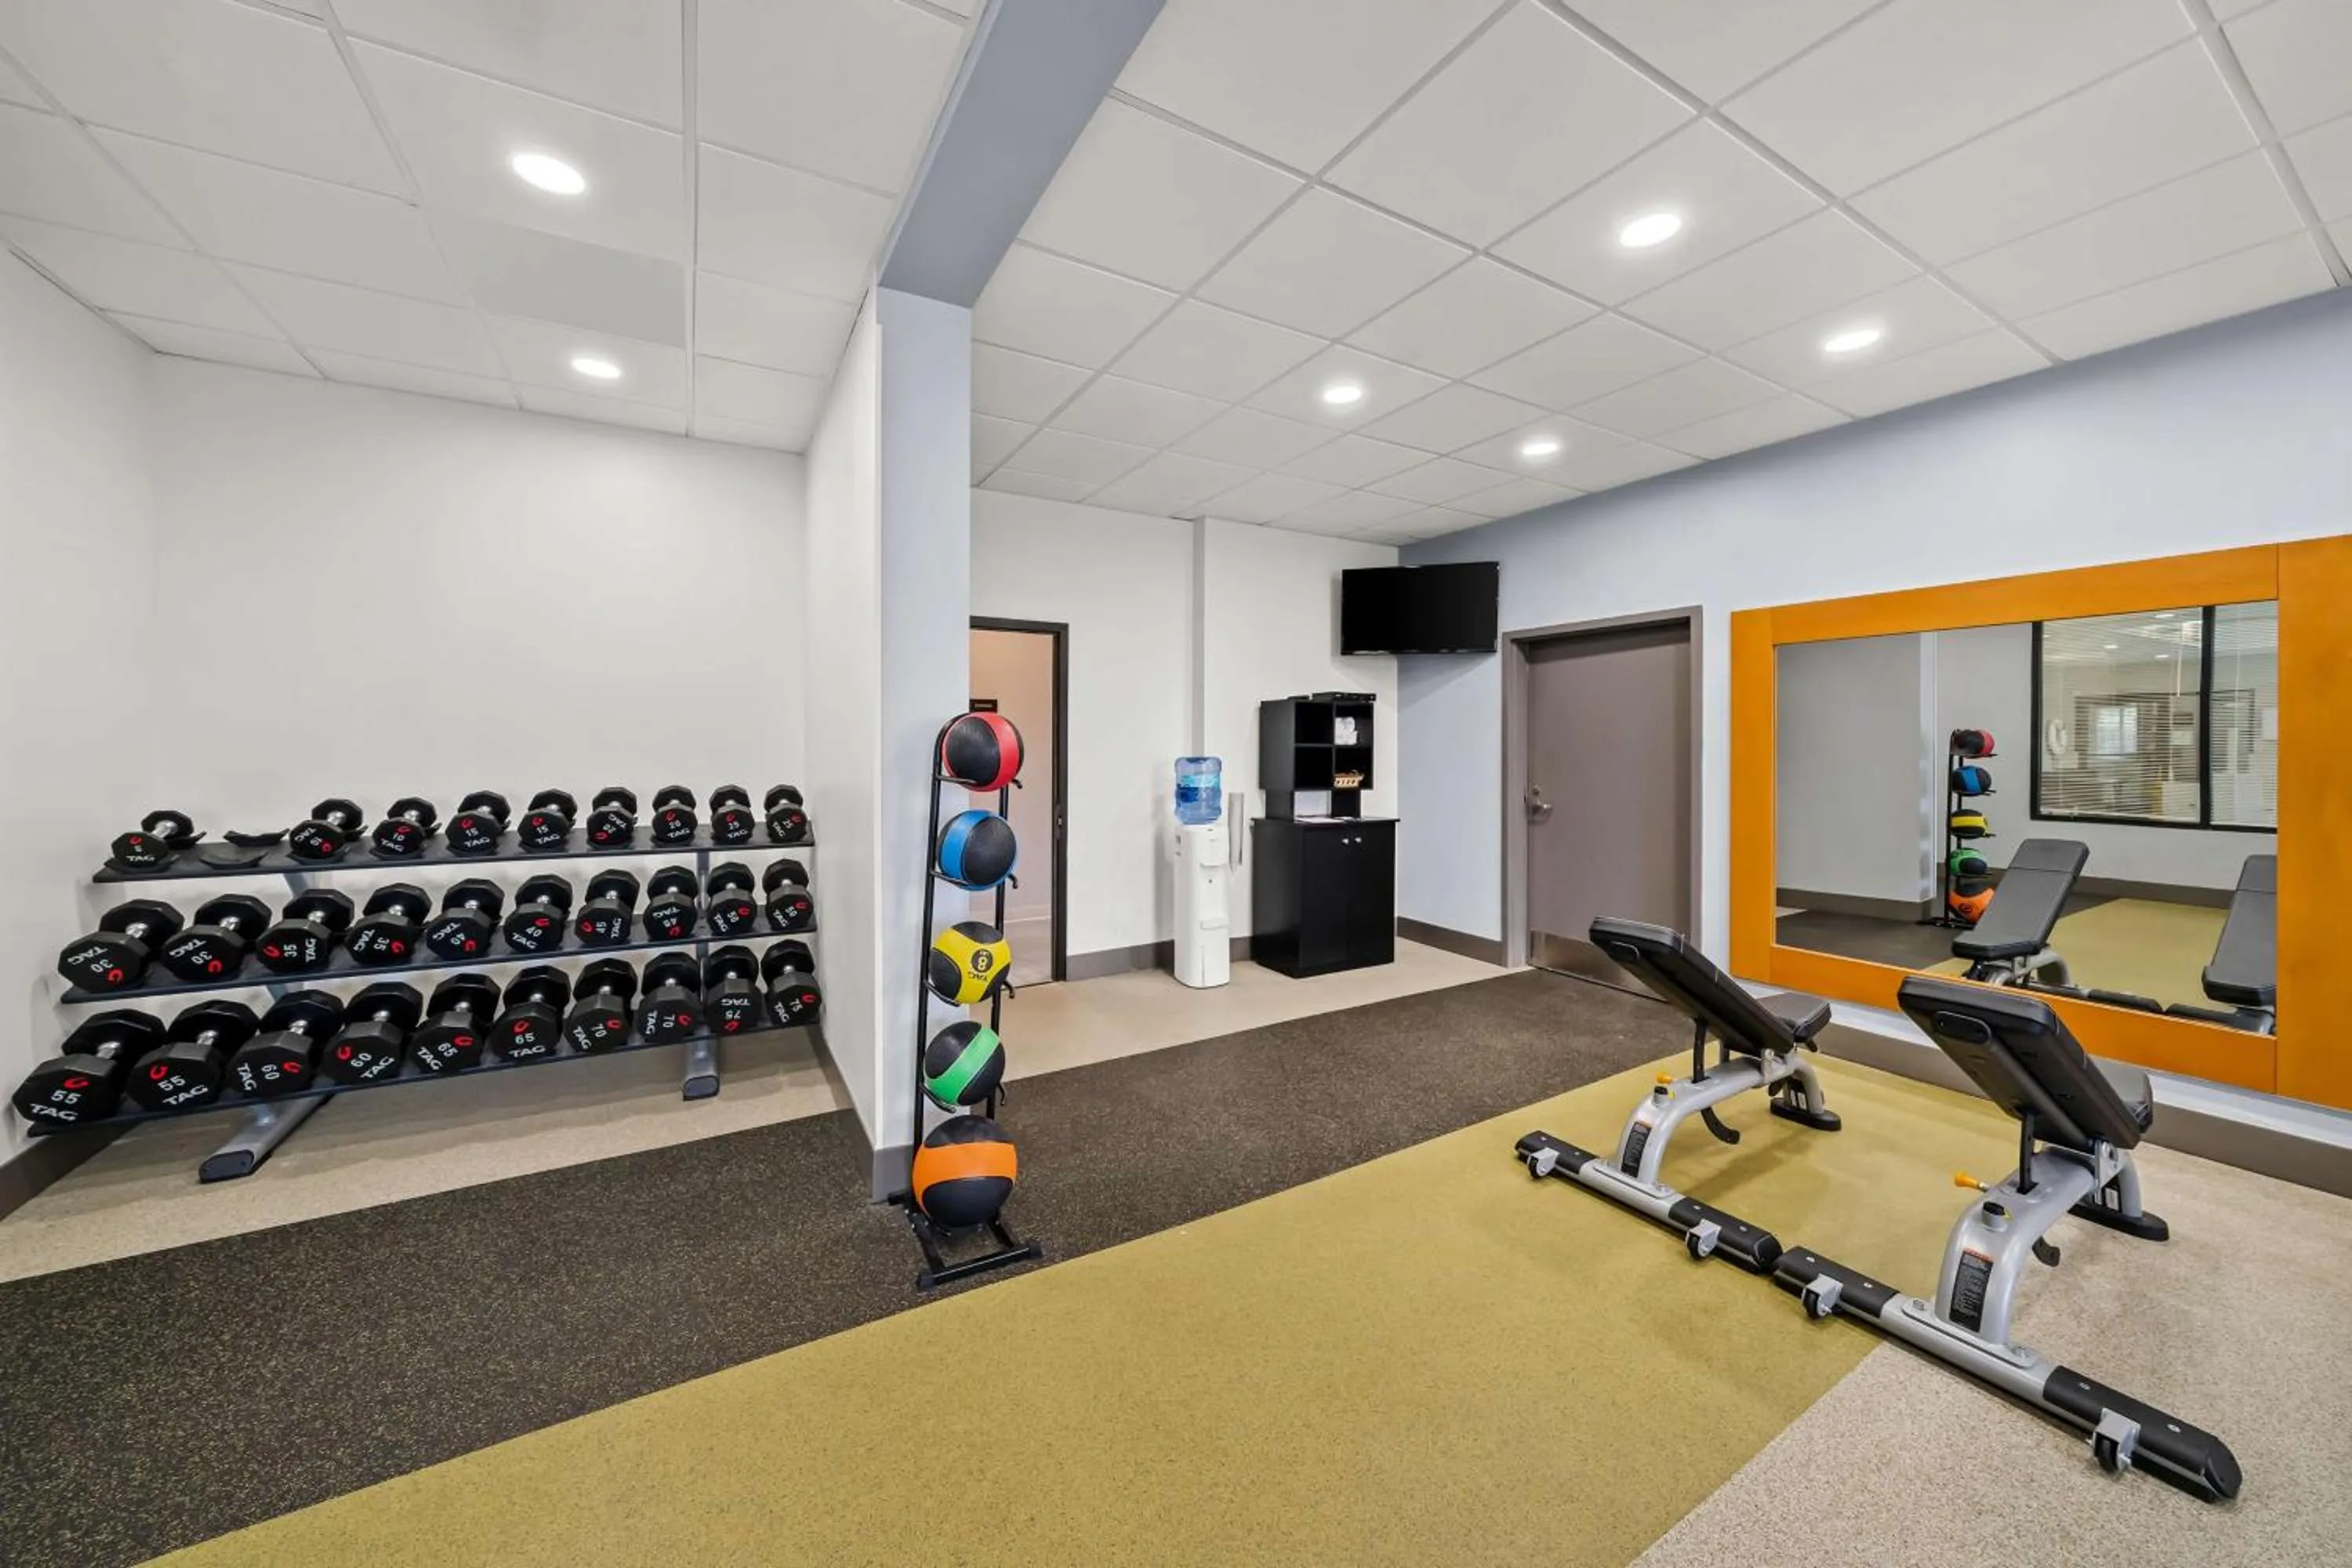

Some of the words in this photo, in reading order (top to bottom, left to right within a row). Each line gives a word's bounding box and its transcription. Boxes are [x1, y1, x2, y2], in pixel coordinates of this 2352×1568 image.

[466, 828, 478, 837] 15
[536, 825, 549, 834] 15
[667, 828, 690, 838] TAG
[464, 837, 490, 848] TAG
[535, 834, 561, 845] TAG
[652, 906, 681, 918] TAG
[595, 921, 607, 934] 45
[611, 916, 622, 939] TAG
[713, 913, 728, 932] TAG
[433, 922, 461, 941] TAG
[451, 932, 466, 946] 40
[525, 926, 543, 938] 40
[169, 938, 207, 958] TAG
[353, 928, 375, 952] TAG
[373, 937, 390, 951] 35
[511, 932, 538, 949] TAG
[67, 946, 109, 966] TAG
[191, 951, 213, 964] 30
[284, 943, 298, 958] 35
[305, 938, 317, 963] TAG
[91, 959, 114, 973] 30
[978, 956, 987, 971] 8
[721, 997, 751, 1006] TAG
[775, 1001, 790, 1023] TAG
[645, 1010, 659, 1035] TAG
[662, 1013, 676, 1029] 70
[572, 1025, 592, 1050] TAG
[591, 1022, 608, 1038] 70
[514, 1032, 535, 1045] 65
[437, 1042, 459, 1058] 65
[509, 1044, 546, 1058] TAG
[350, 1052, 373, 1068] 60
[416, 1046, 444, 1071] TAG
[261, 1064, 281, 1080] 60
[360, 1056, 395, 1080] TAG
[157, 1075, 187, 1091] 55
[237, 1062, 257, 1091] TAG
[50, 1089, 82, 1105] 55
[162, 1083, 209, 1105] TAG
[29, 1103, 78, 1121] TAG
